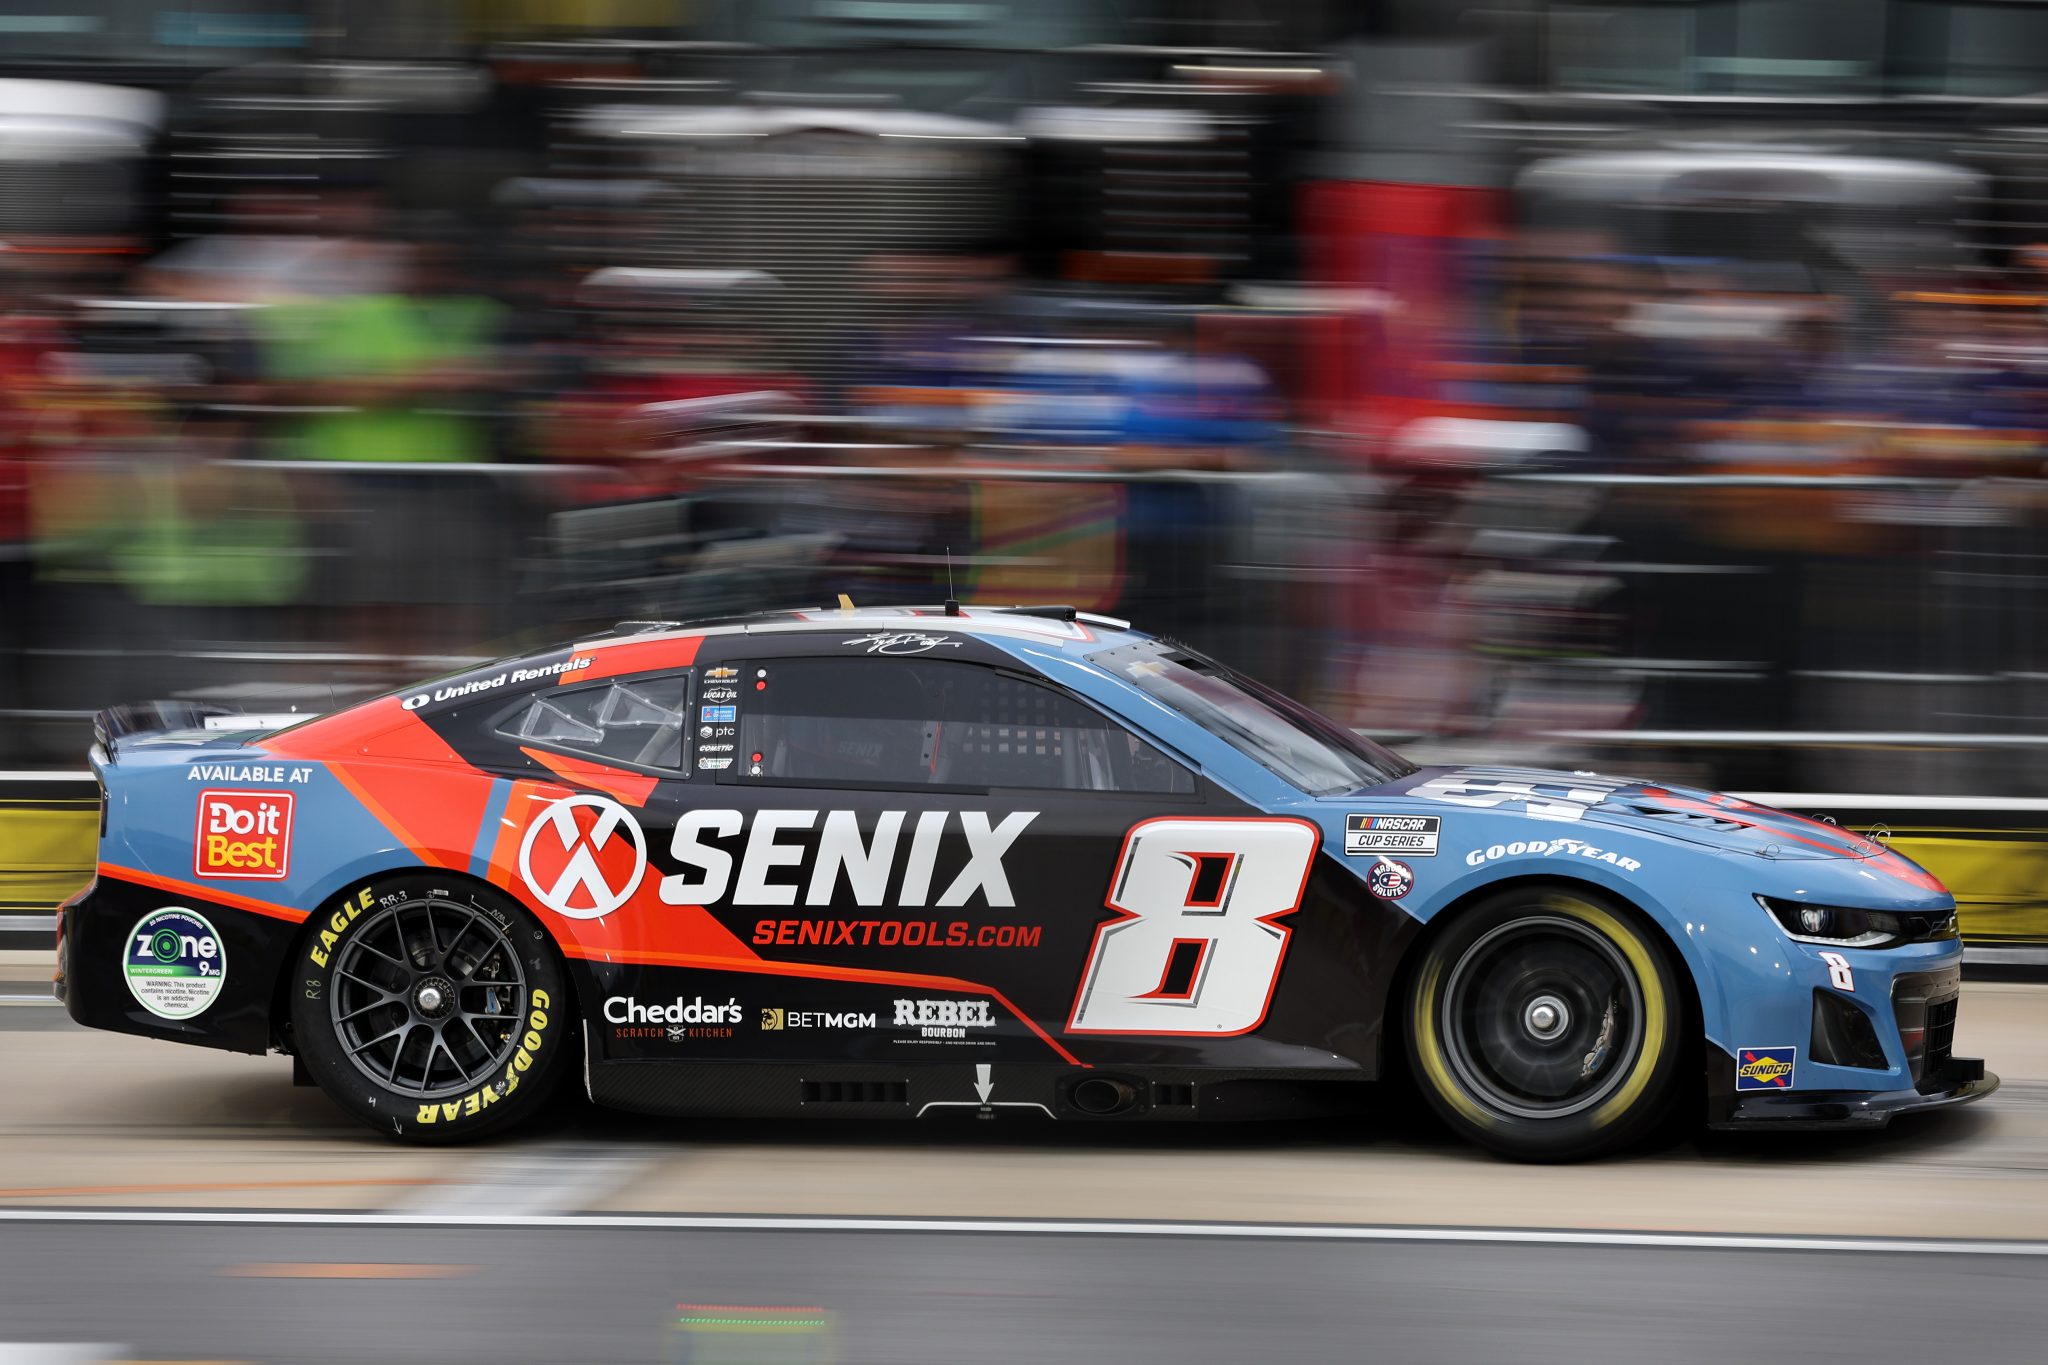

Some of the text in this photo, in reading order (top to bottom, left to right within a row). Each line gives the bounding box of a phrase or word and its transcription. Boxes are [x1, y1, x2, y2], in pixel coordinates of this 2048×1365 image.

[433, 656, 592, 702] United Rentals
[703, 691, 726, 699] LUCAS
[716, 726, 735, 738] ptc
[187, 765, 313, 784] AVAILABLE AT
[209, 802, 281, 835] Do it
[1375, 817, 1427, 831] NASCAR
[1358, 834, 1425, 847] CUP SERIES
[206, 835, 278, 869] Best
[658, 809, 1041, 907] SENIX
[1466, 838, 1642, 873] GOODYEAR
[1373, 863, 1412, 879] NAS
[1372, 883, 1408, 897] SALUTES
[156, 913, 181, 923] NICOTINE
[181, 914, 204, 930] POUCHES
[310, 886, 375, 969] EAGLE
[1064, 816, 1321, 1037] 8
[752, 920, 1042, 948] SENIXTOOLS.COM
[136, 929, 218, 963] zone
[129, 967, 174, 975] WINTERGREEN
[1818, 951, 1856, 992] 8
[141, 988, 164, 996] contains
[188, 989, 210, 997] Nicotine
[603, 996, 743, 1024] Cheddar's
[893, 998, 997, 1028] REBEL
[787, 1012, 876, 1029] BETMGM
[616, 1026, 733, 1039] SCRATCH KITCHEN
[921, 1027, 966, 1039] BOURBON
[416, 988, 551, 1124] GOODYEAR
[1741, 1063, 1790, 1076] SUNOCO
